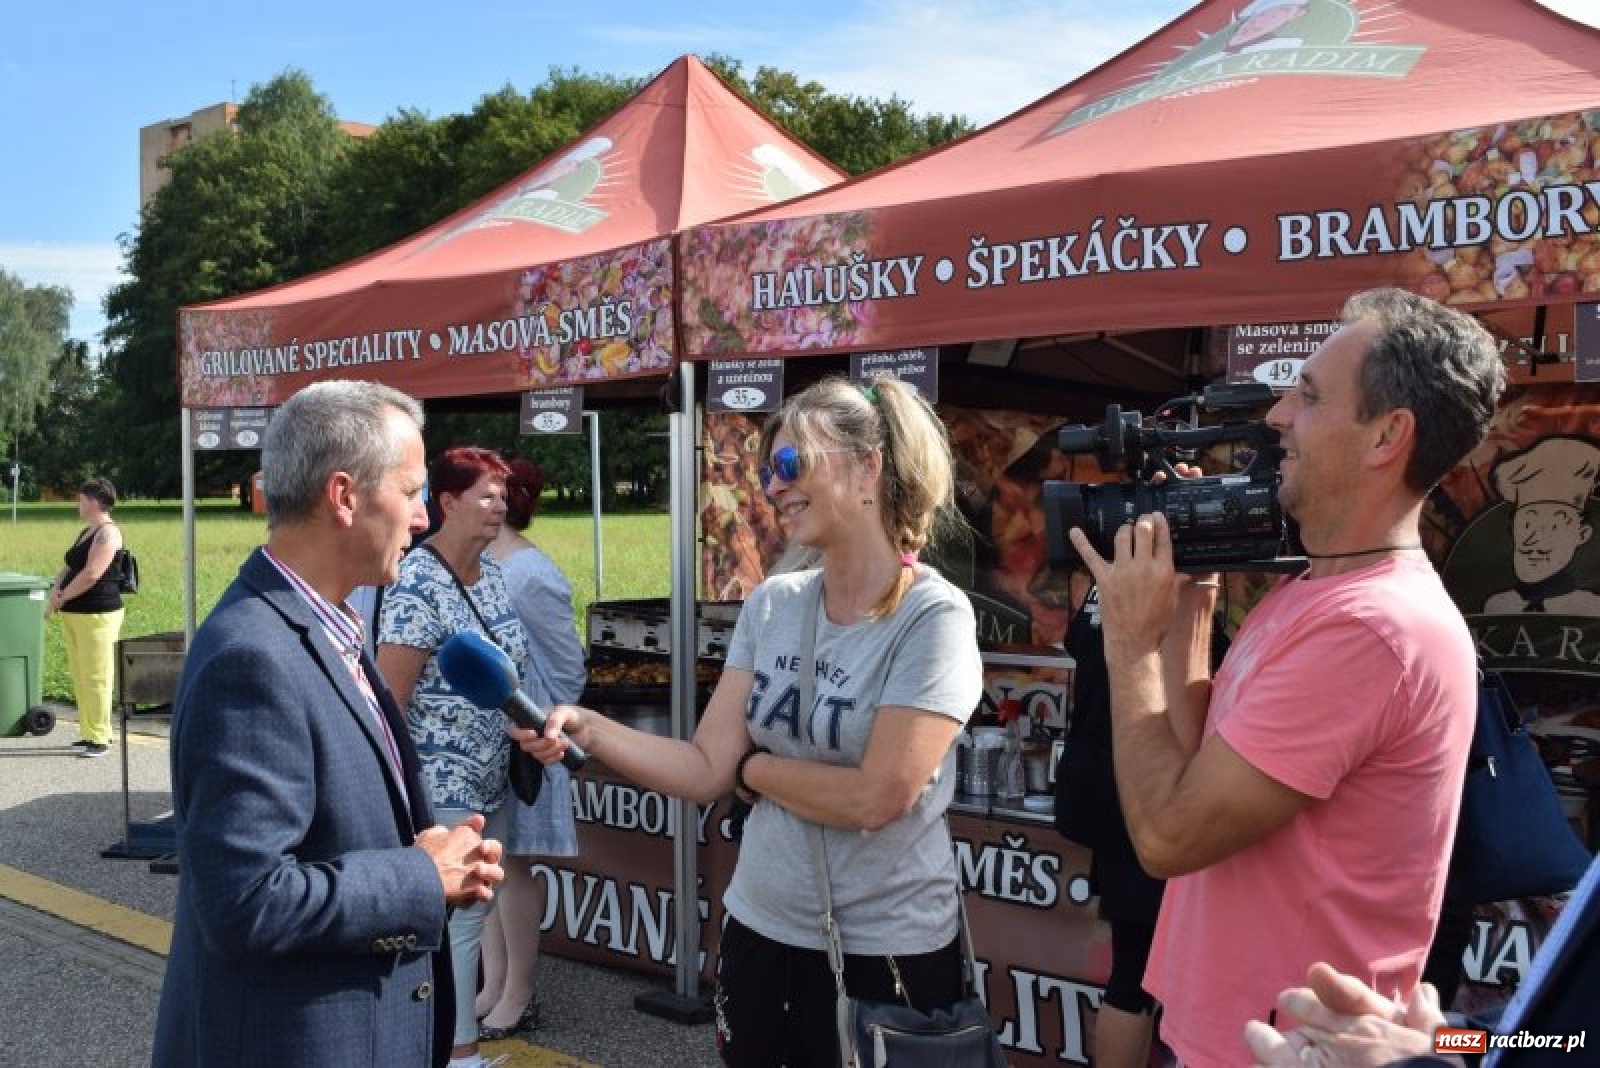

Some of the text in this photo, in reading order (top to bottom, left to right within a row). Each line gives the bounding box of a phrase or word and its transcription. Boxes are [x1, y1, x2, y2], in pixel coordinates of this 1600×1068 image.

[752, 252, 924, 310] HALUŠKY
[966, 217, 1209, 288] ŠPEKÁČKY
[200, 296, 632, 376] GRILOVANÉ SPECIALITY MASOVÁ SMĚS
